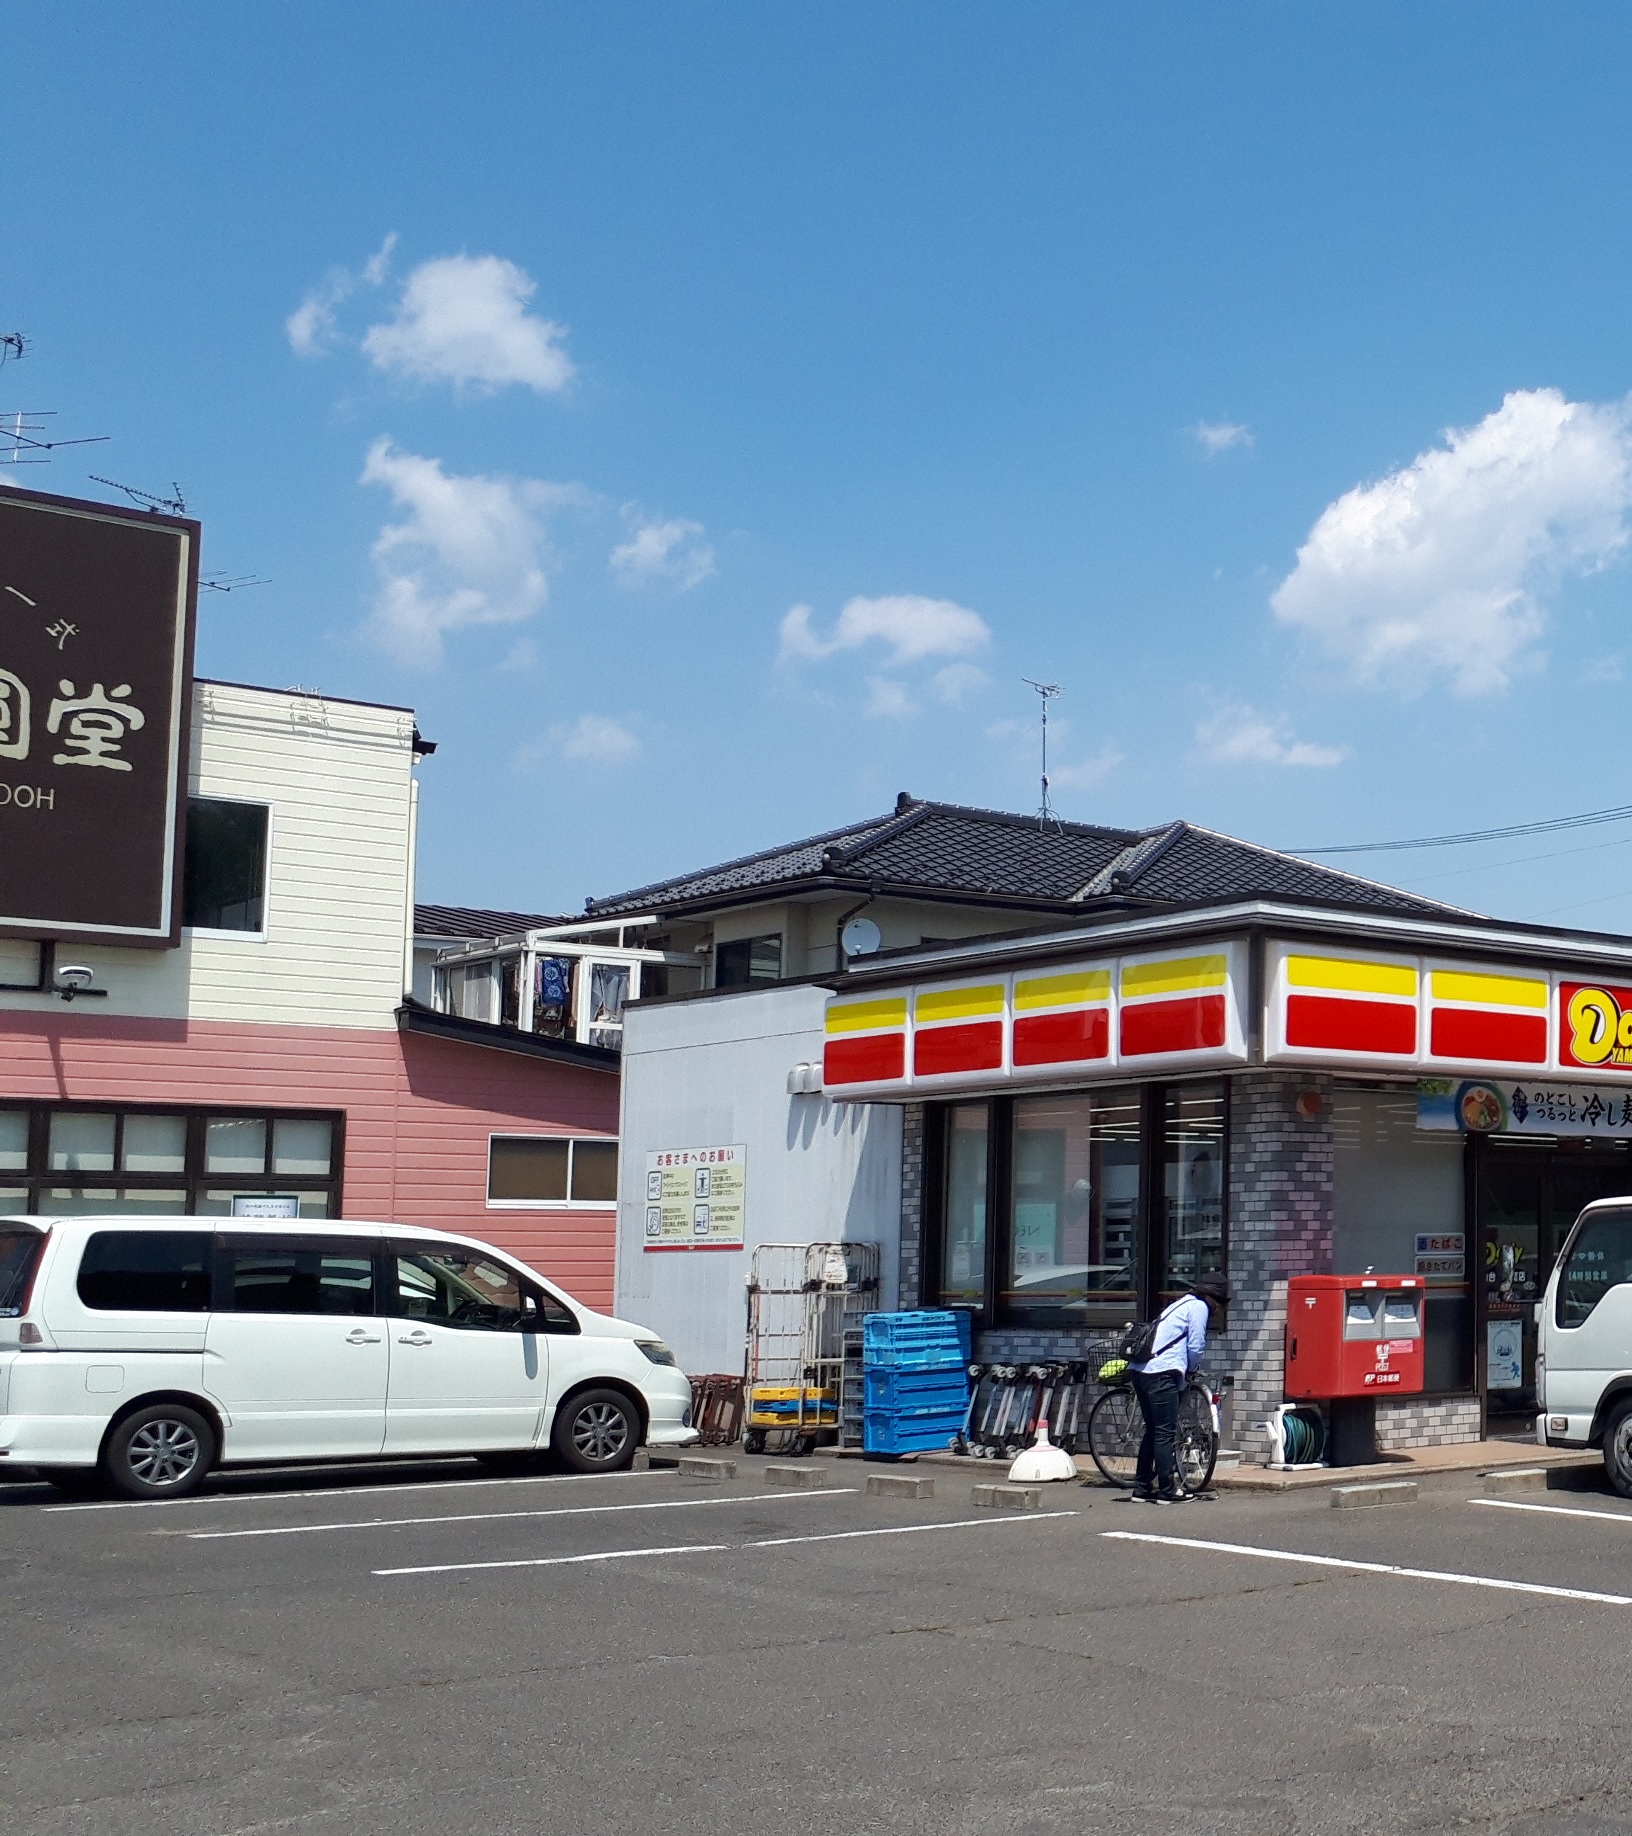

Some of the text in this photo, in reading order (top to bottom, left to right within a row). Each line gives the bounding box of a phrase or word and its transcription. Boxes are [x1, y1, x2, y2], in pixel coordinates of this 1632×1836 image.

[1534, 1092, 1577, 1107] のどごし
[1536, 1107, 1577, 1122] つるっと
[657, 1150, 734, 1165] お客さまへのお願い
